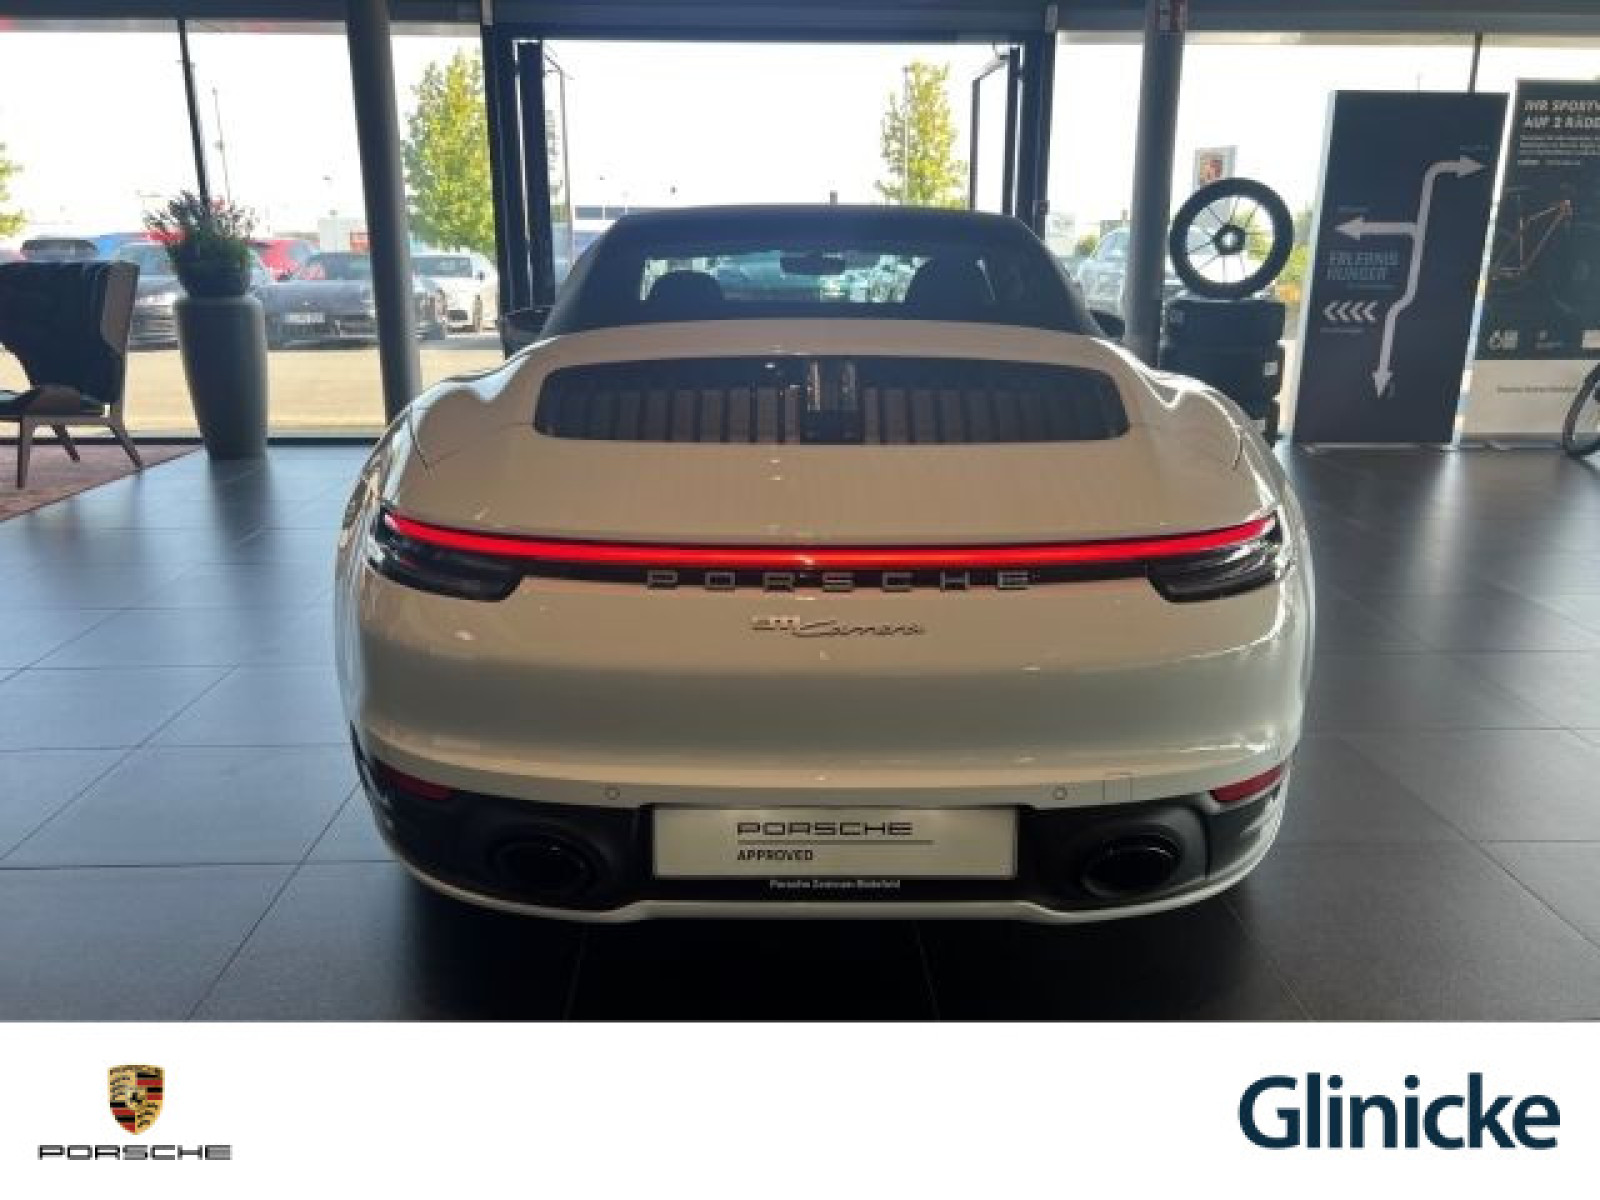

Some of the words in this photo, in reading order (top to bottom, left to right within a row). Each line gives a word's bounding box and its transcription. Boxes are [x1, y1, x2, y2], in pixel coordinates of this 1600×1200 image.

[1524, 116, 1550, 128] AUF
[1554, 116, 1561, 128] 2
[646, 570, 1031, 592] PORSCHE
[751, 615, 801, 631] 911
[793, 619, 926, 638] Carrera
[737, 821, 914, 836] PORSCHE
[736, 849, 814, 861] APPROVED
[769, 879, 811, 889] Porsche
